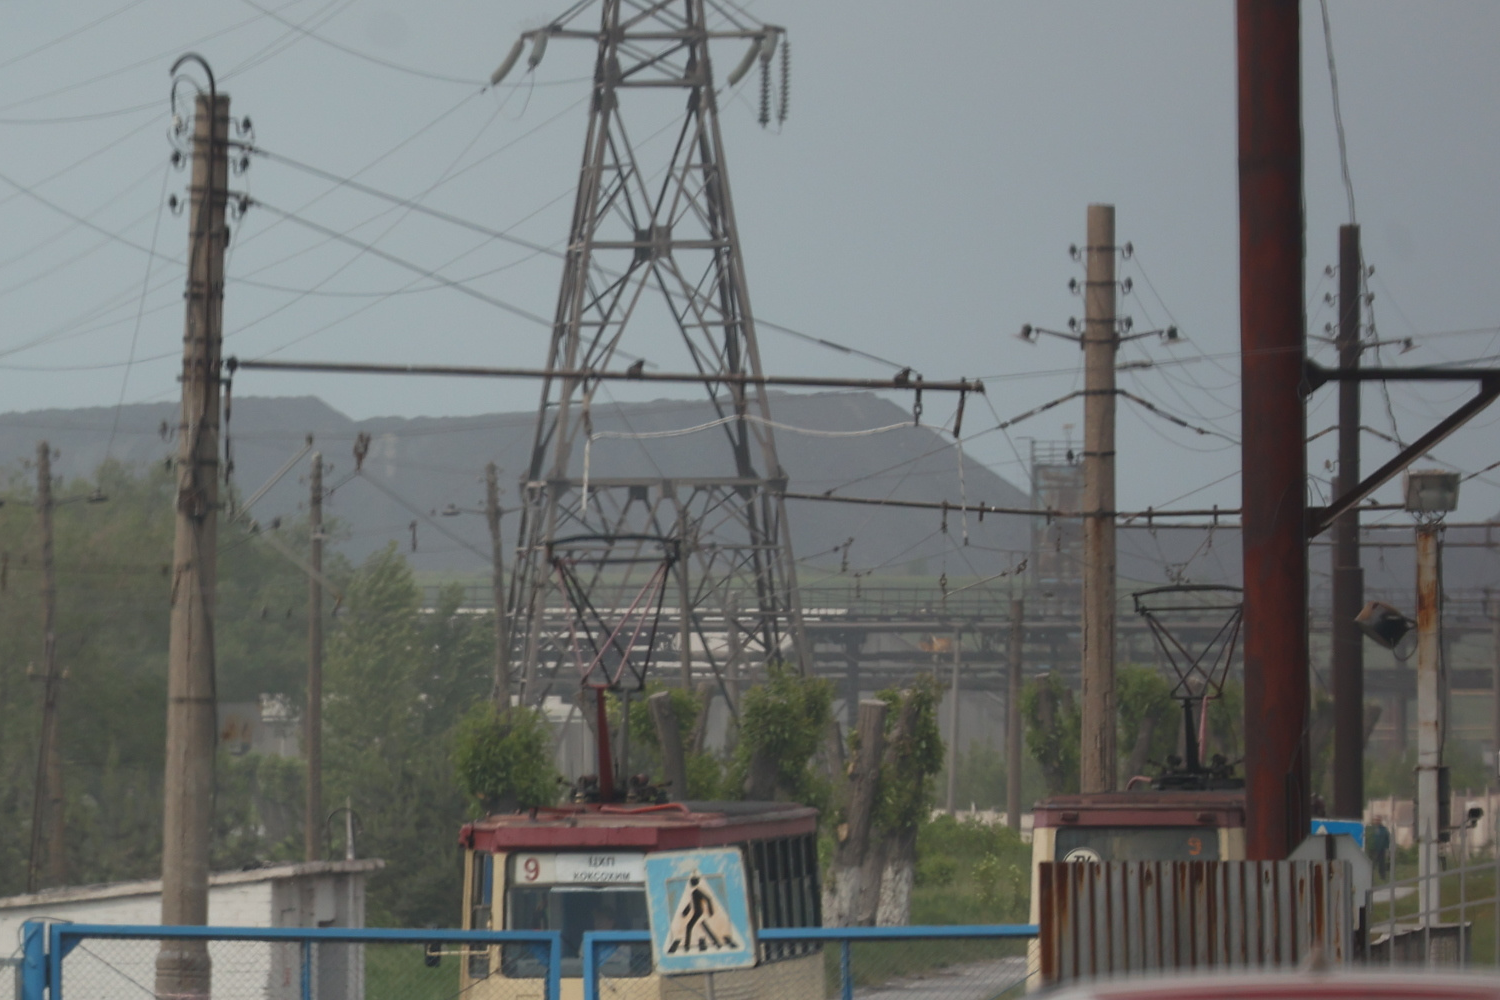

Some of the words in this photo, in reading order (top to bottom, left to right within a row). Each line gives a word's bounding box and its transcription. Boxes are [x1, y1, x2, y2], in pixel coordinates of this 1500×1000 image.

[1188, 837, 1202, 855] 9
[524, 857, 540, 881] 9
[588, 855, 616, 868] ЦХП
[573, 871, 631, 882] КОКСОХИМ
